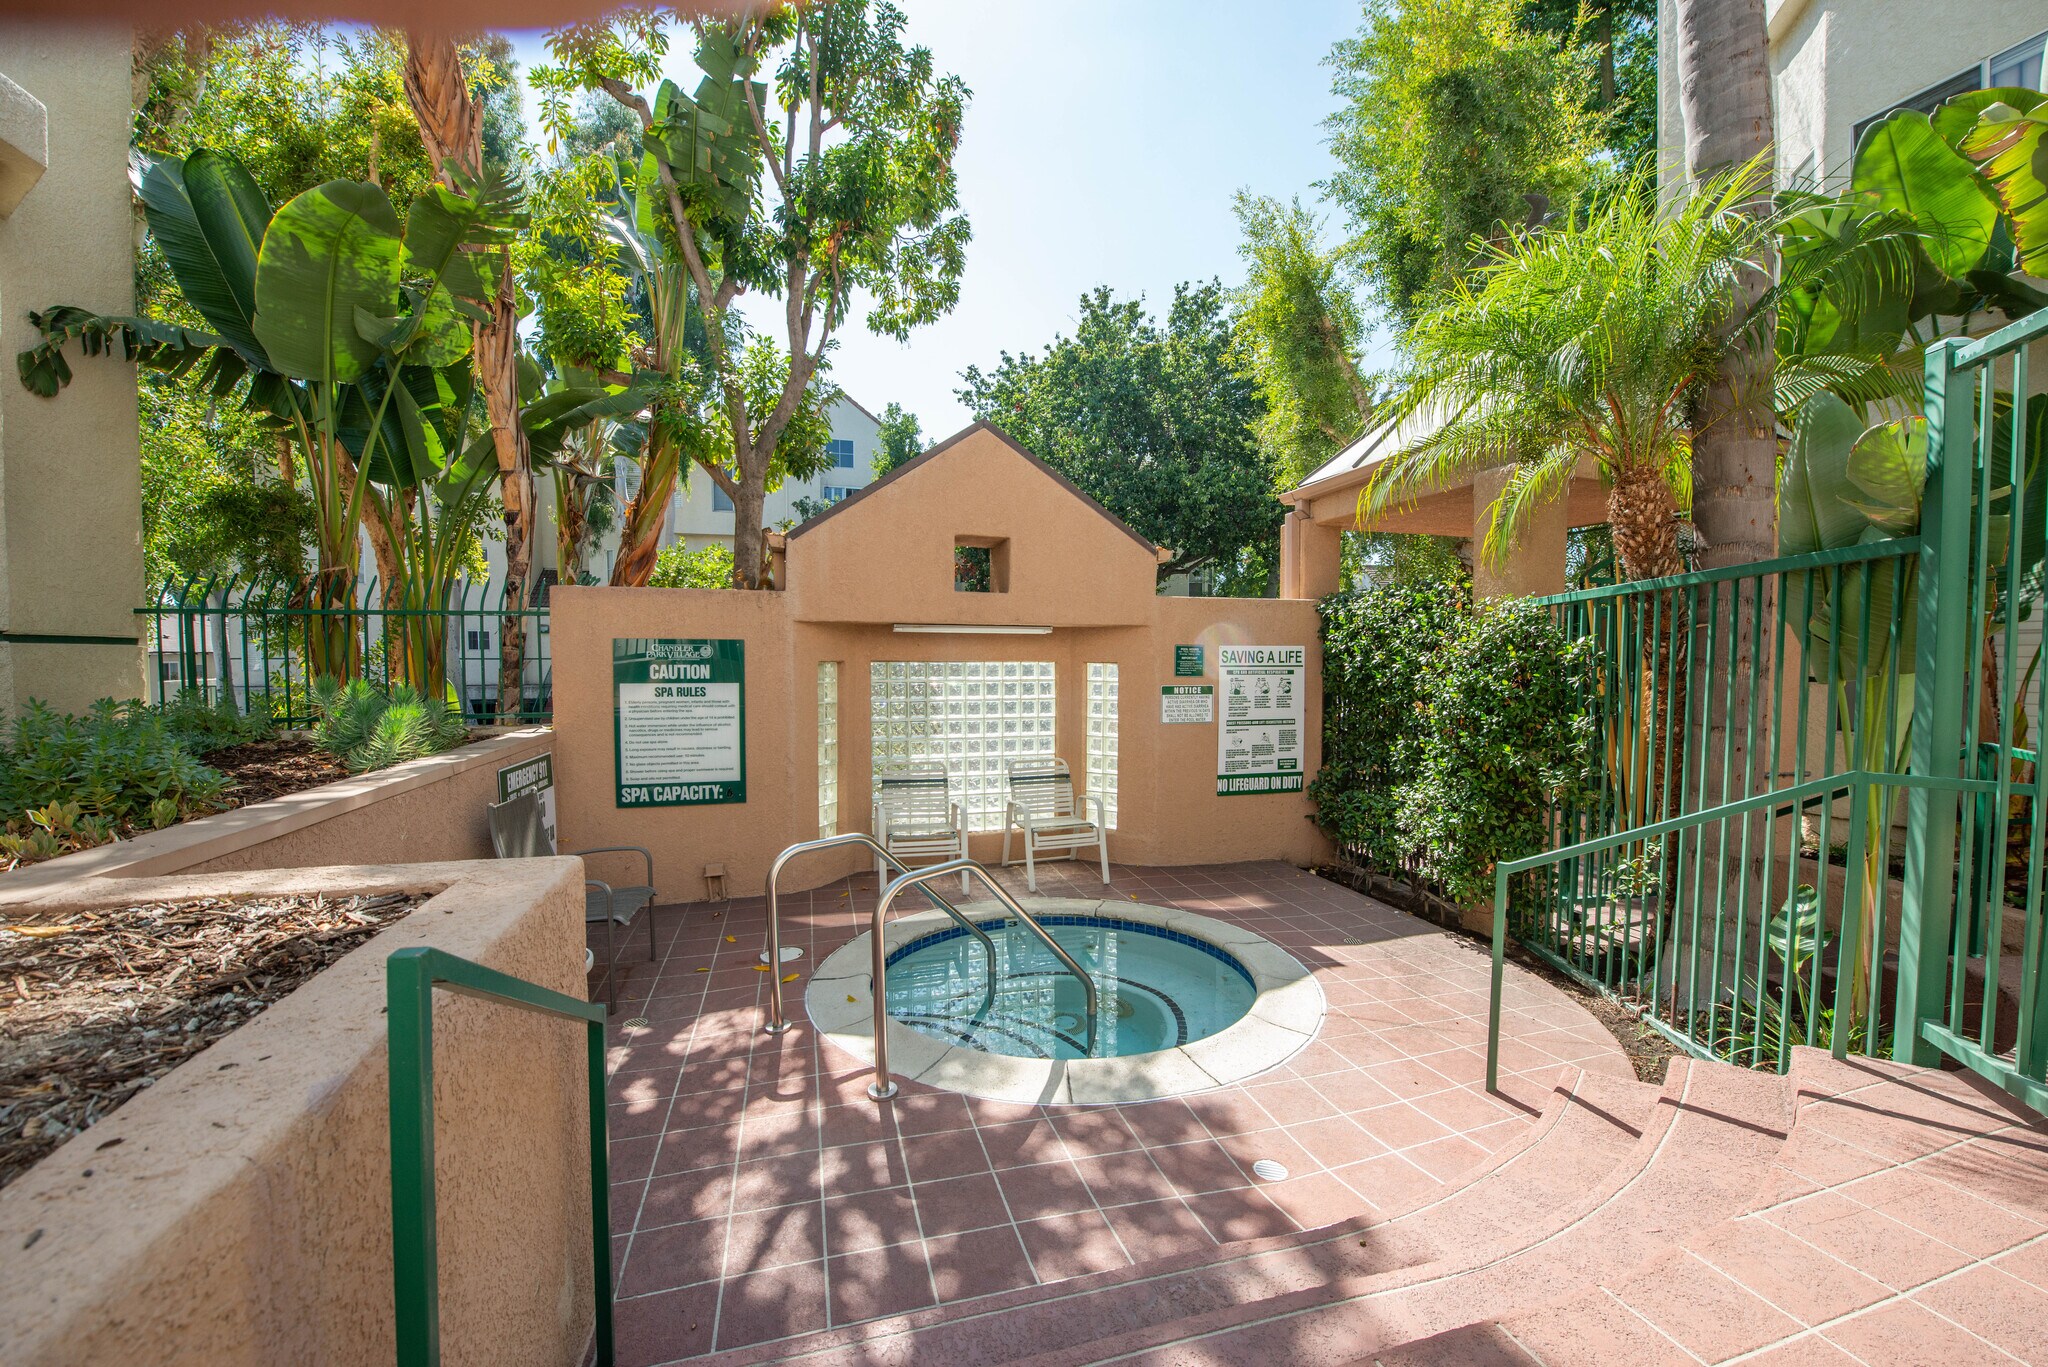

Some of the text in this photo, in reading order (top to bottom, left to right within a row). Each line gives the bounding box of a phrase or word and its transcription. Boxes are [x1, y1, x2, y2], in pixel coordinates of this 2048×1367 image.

[1222, 650, 1302, 664] SAVING A LIFE
[650, 664, 710, 679] CAUTION
[655, 687, 706, 697] SPA RULES
[507, 762, 538, 793] EMERGENCY
[1218, 776, 1302, 792] NO LIFEGUARD ON DUTY
[621, 787, 649, 803] SPA
[653, 785, 723, 802] CAPACITY:
